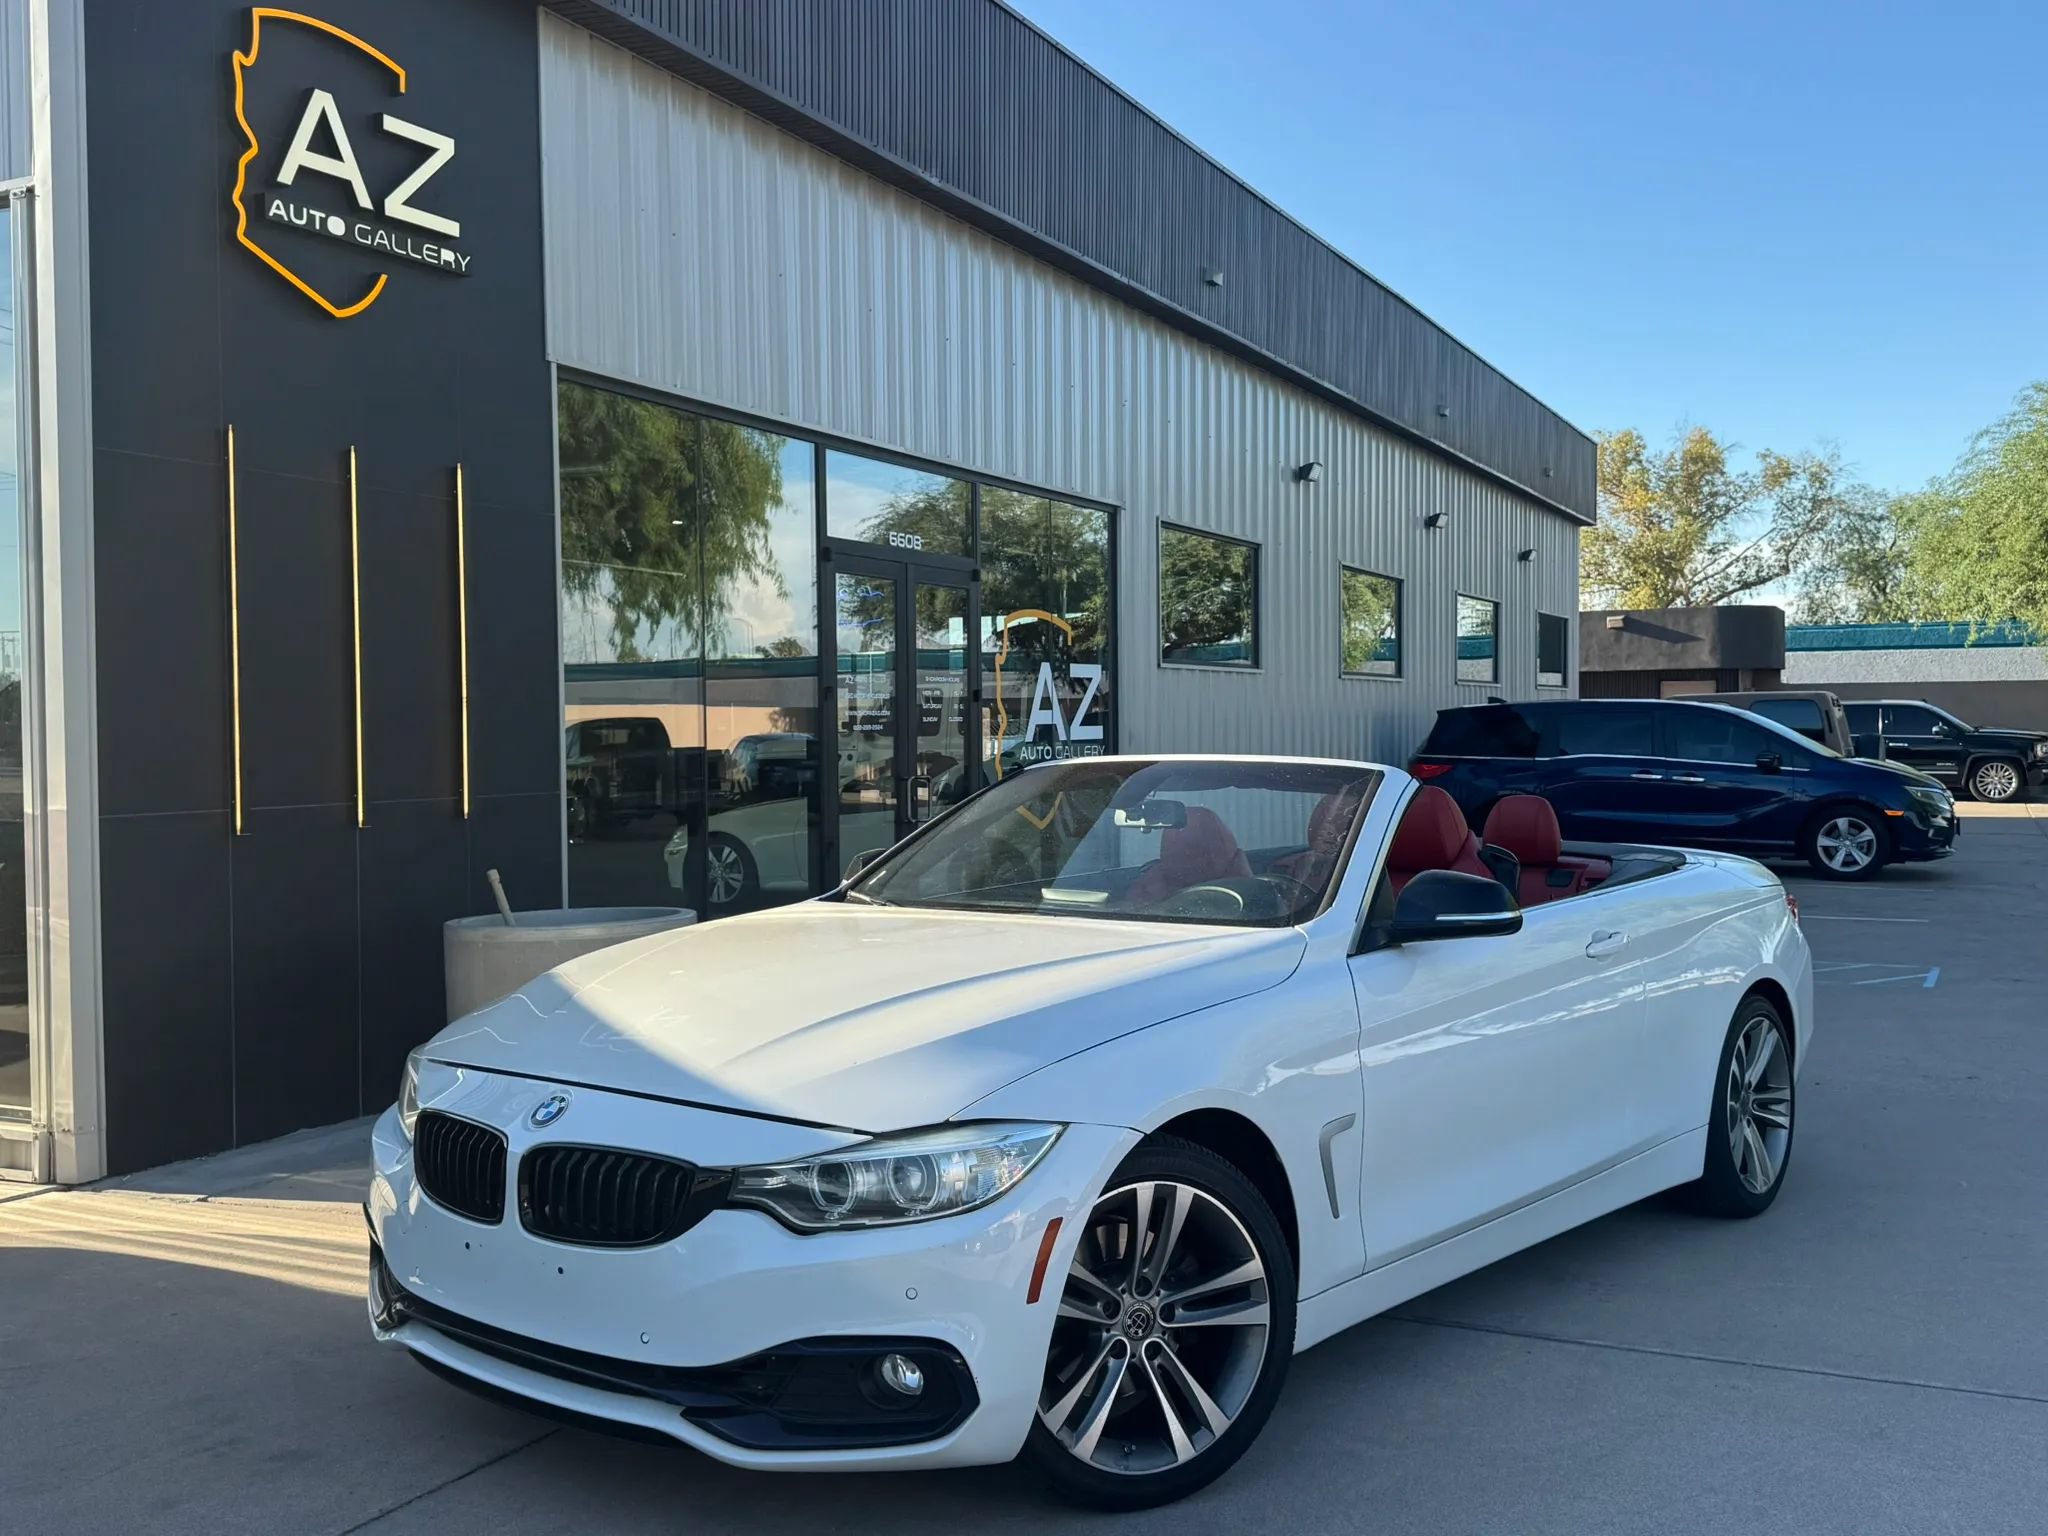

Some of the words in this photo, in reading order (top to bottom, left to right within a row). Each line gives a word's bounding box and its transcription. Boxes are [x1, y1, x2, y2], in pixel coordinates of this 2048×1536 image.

[276, 88, 460, 238] AZ
[268, 199, 346, 237] AUTO
[354, 223, 471, 272] GALLERY
[889, 531, 922, 550] 6608
[1025, 662, 1104, 742] AZ
[1019, 745, 1052, 760] AUTO
